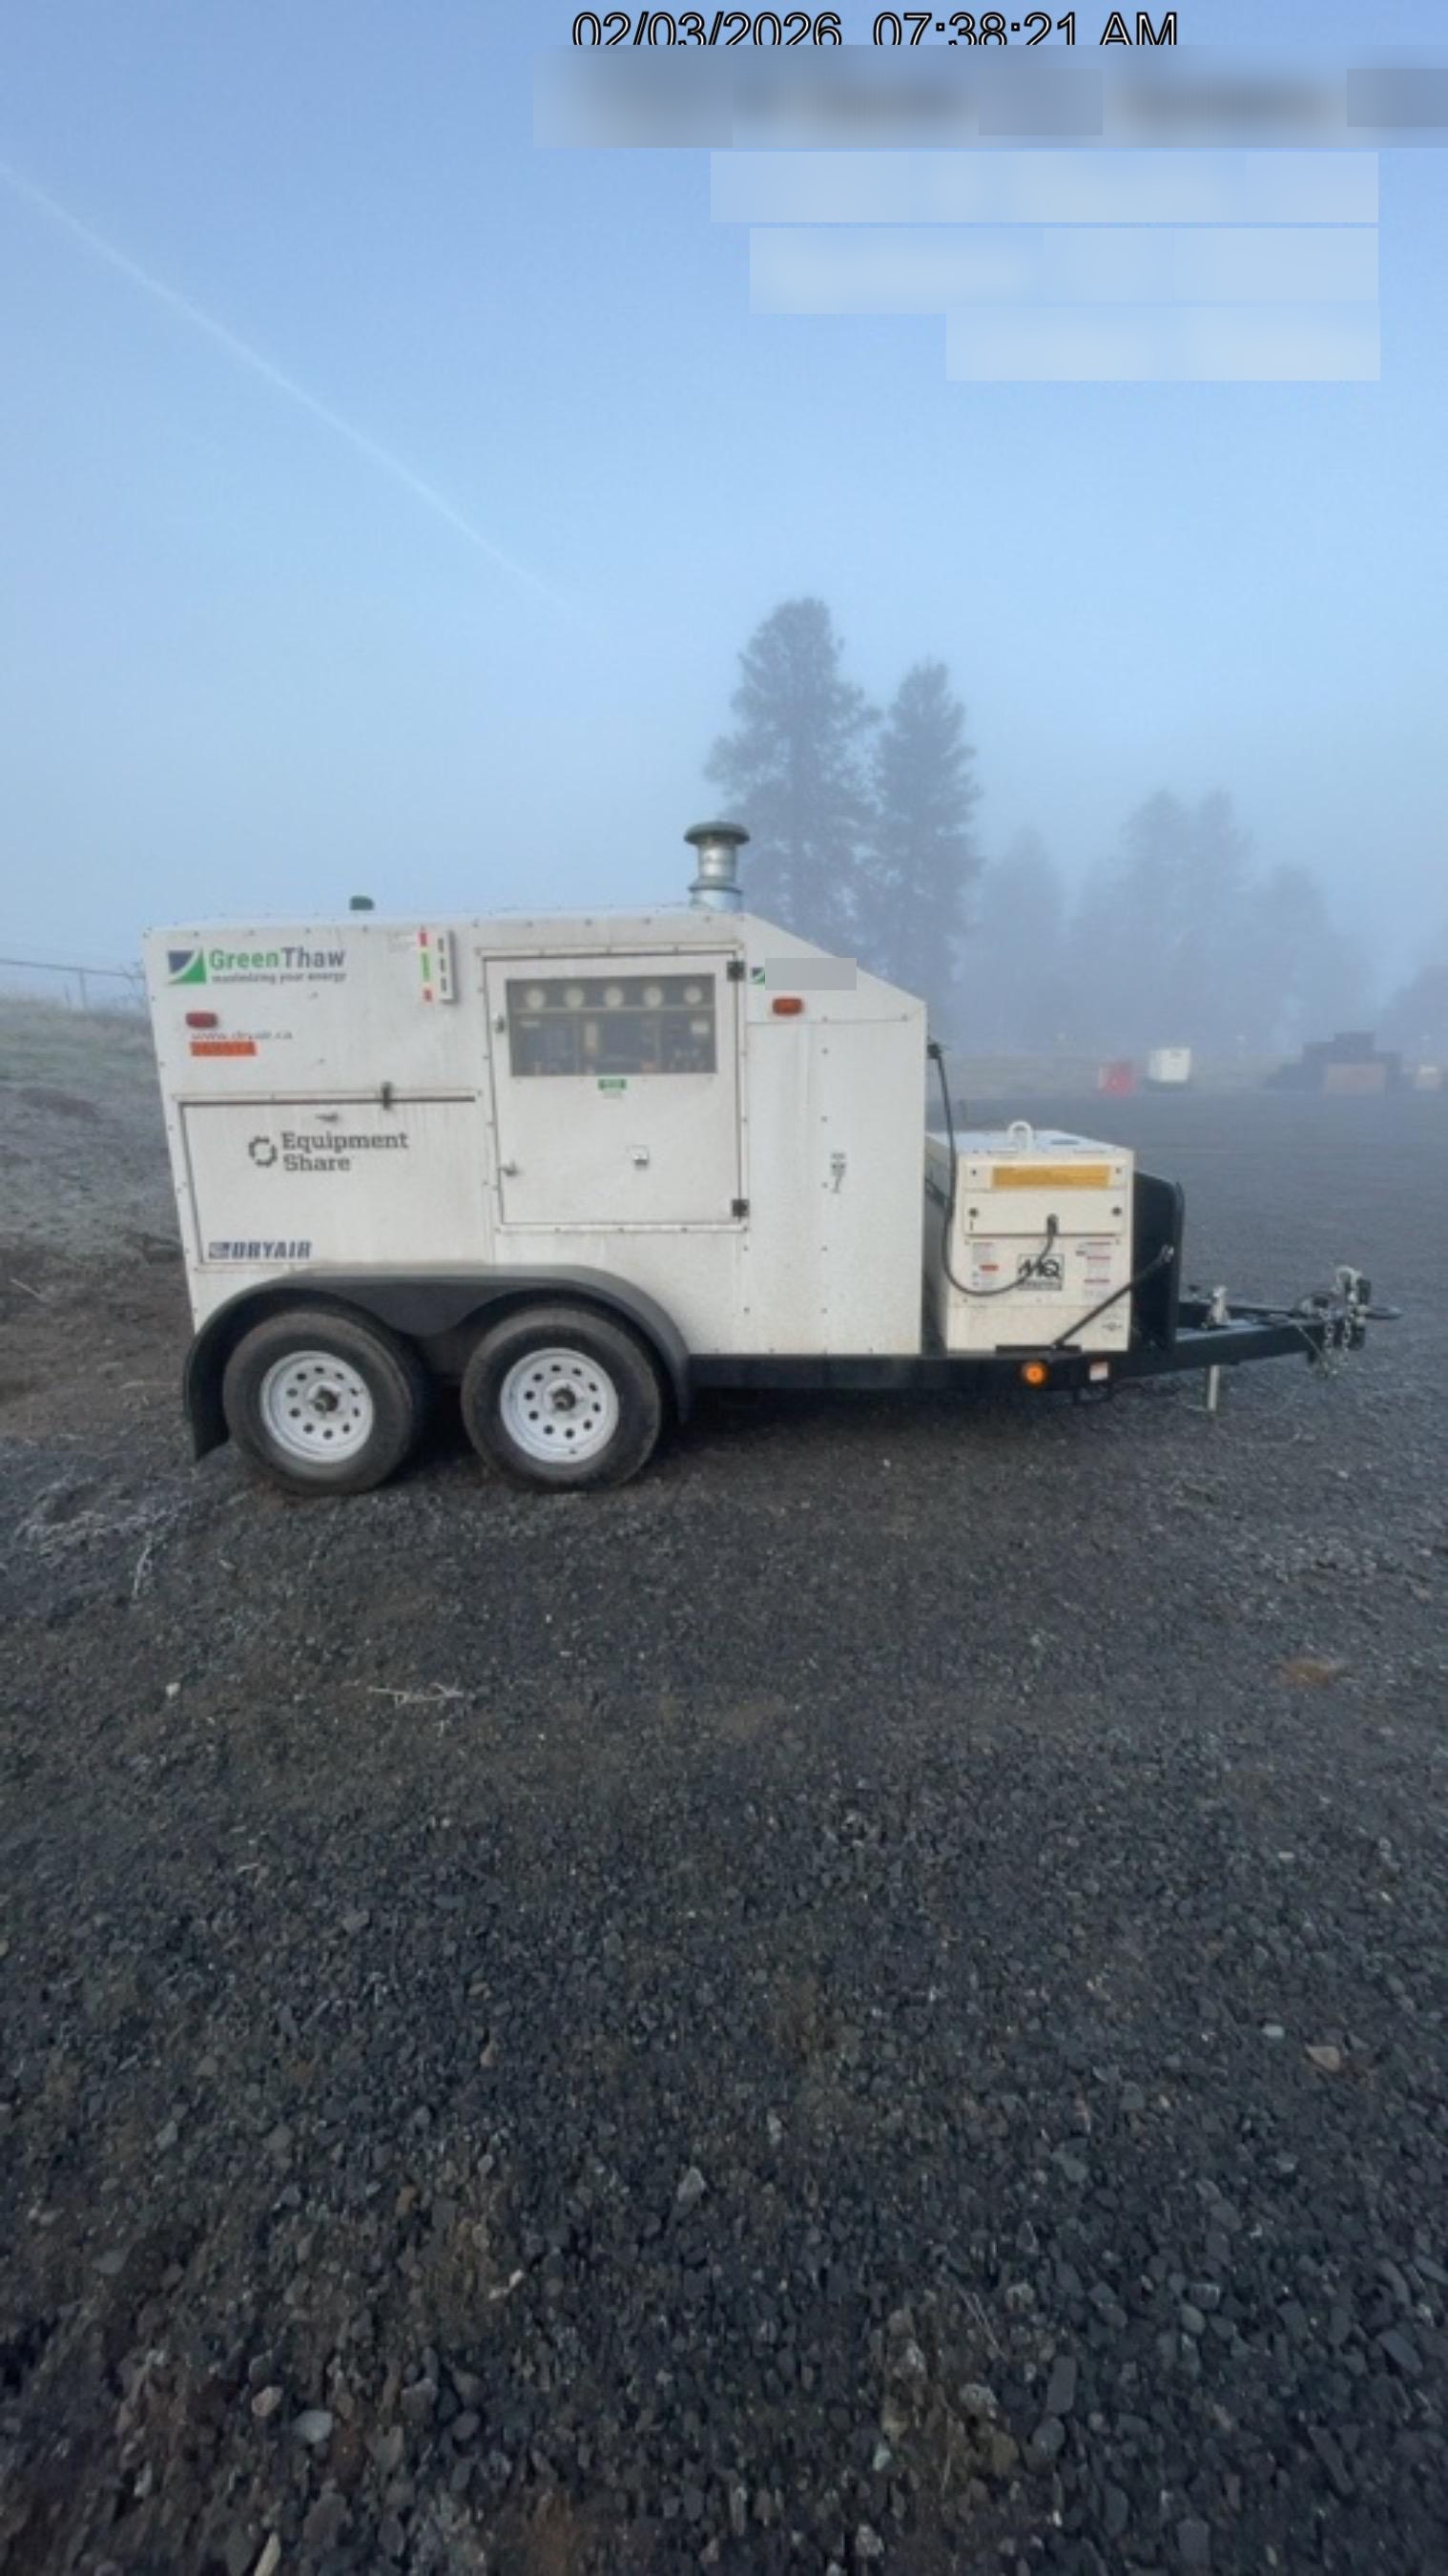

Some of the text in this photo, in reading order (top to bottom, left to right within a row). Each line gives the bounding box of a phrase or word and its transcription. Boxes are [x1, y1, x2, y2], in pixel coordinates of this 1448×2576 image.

[280, 1131, 409, 1153] Equipment
[282, 1153, 351, 1172] Share
[231, 1241, 312, 1260] DRYAIR
